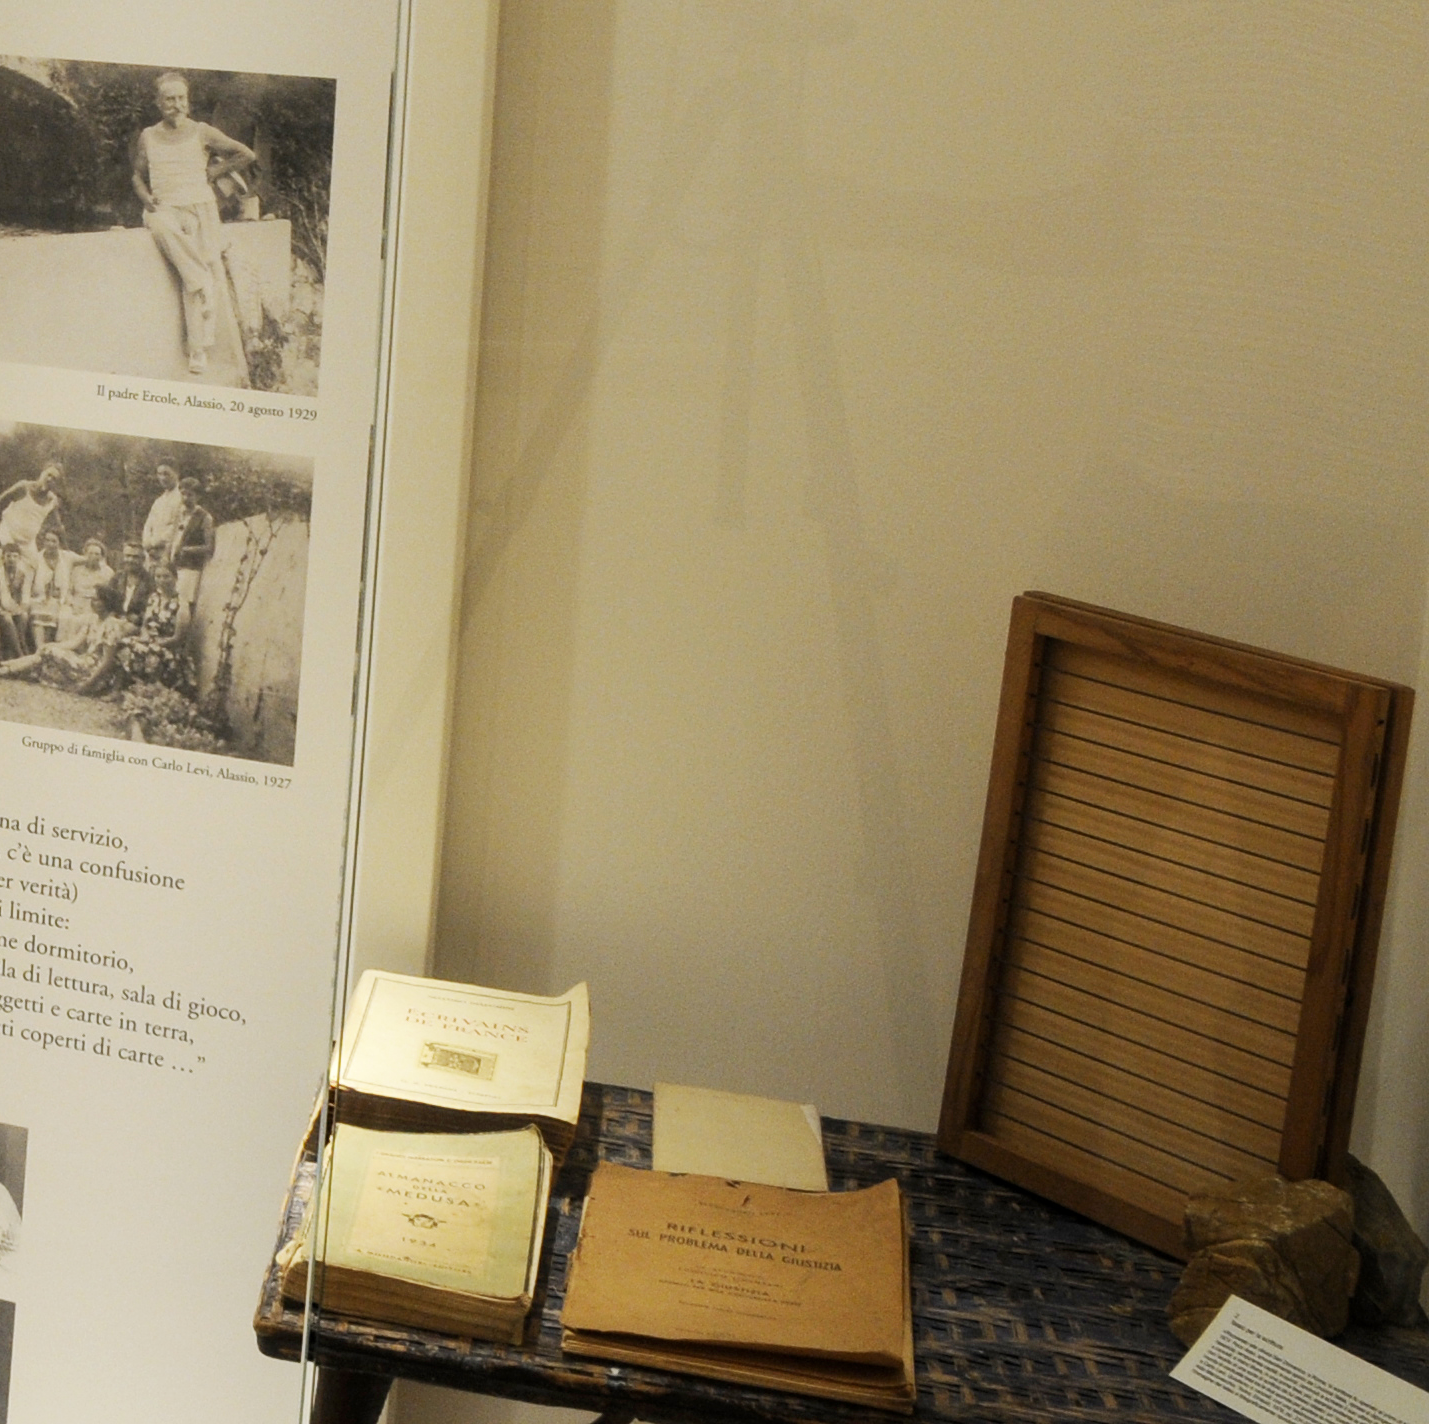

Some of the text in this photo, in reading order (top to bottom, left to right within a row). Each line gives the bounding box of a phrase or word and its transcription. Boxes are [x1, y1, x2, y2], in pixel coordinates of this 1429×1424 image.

[97, 385, 317, 421] Il padre Ercole, Alassio, 20 agosto 1929
[22, 737, 292, 788] Gruppo di famiglia con Carlo Levi, Alassio, 1927
[27, 816, 45, 835] di
[52, 827, 128, 852] servizio,
[39, 854, 72, 870] una
[80, 861, 185, 890] confusione
[20, 879, 78, 903] verità)
[10, 901, 69, 929] limite:
[24, 935, 133, 973] dormitorio,
[405, 1016, 529, 1043] DE FRANCE
[377, 1170, 487, 1191] ALMANACCO
[627, 1228, 843, 1272] SUL PROBLEMA DELLA GIUSTIZIA
[666, 1222, 807, 1253] RIFLESSIONI
